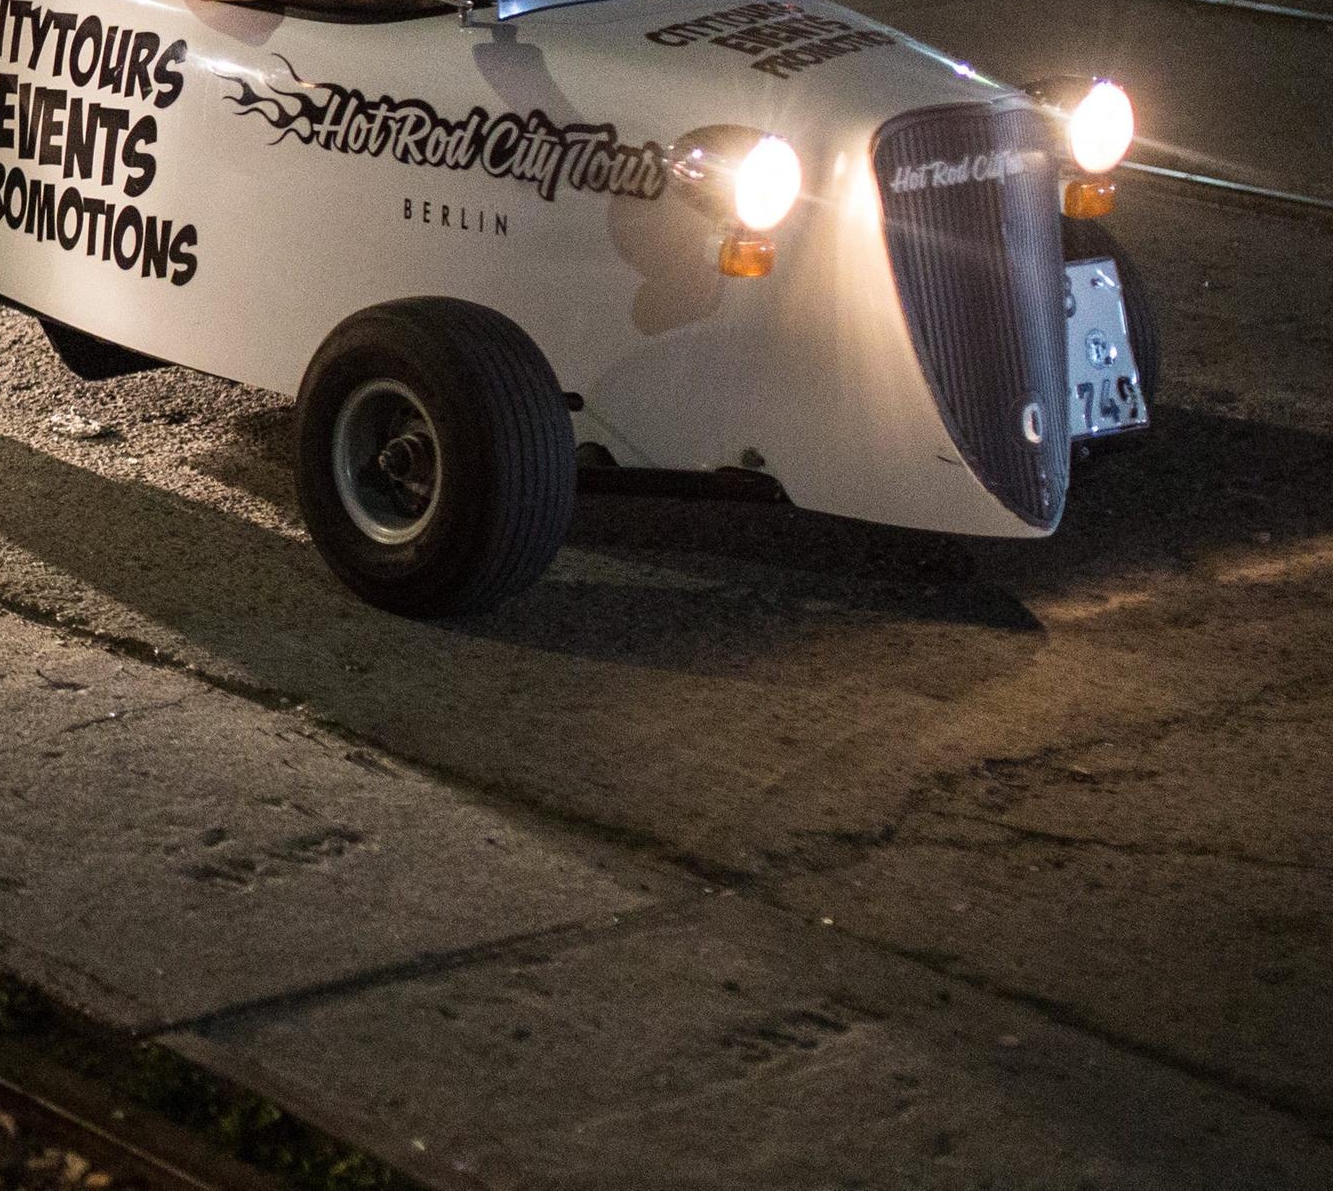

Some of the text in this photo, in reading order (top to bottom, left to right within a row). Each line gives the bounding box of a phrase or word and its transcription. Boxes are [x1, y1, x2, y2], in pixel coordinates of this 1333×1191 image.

[313, 92, 396, 157] Hot
[388, 105, 481, 168] Rod
[481, 111, 562, 201] City
[889, 165, 929, 194] Hot
[930, 156, 970, 188] Rod
[403, 198, 509, 236] BERLIN
